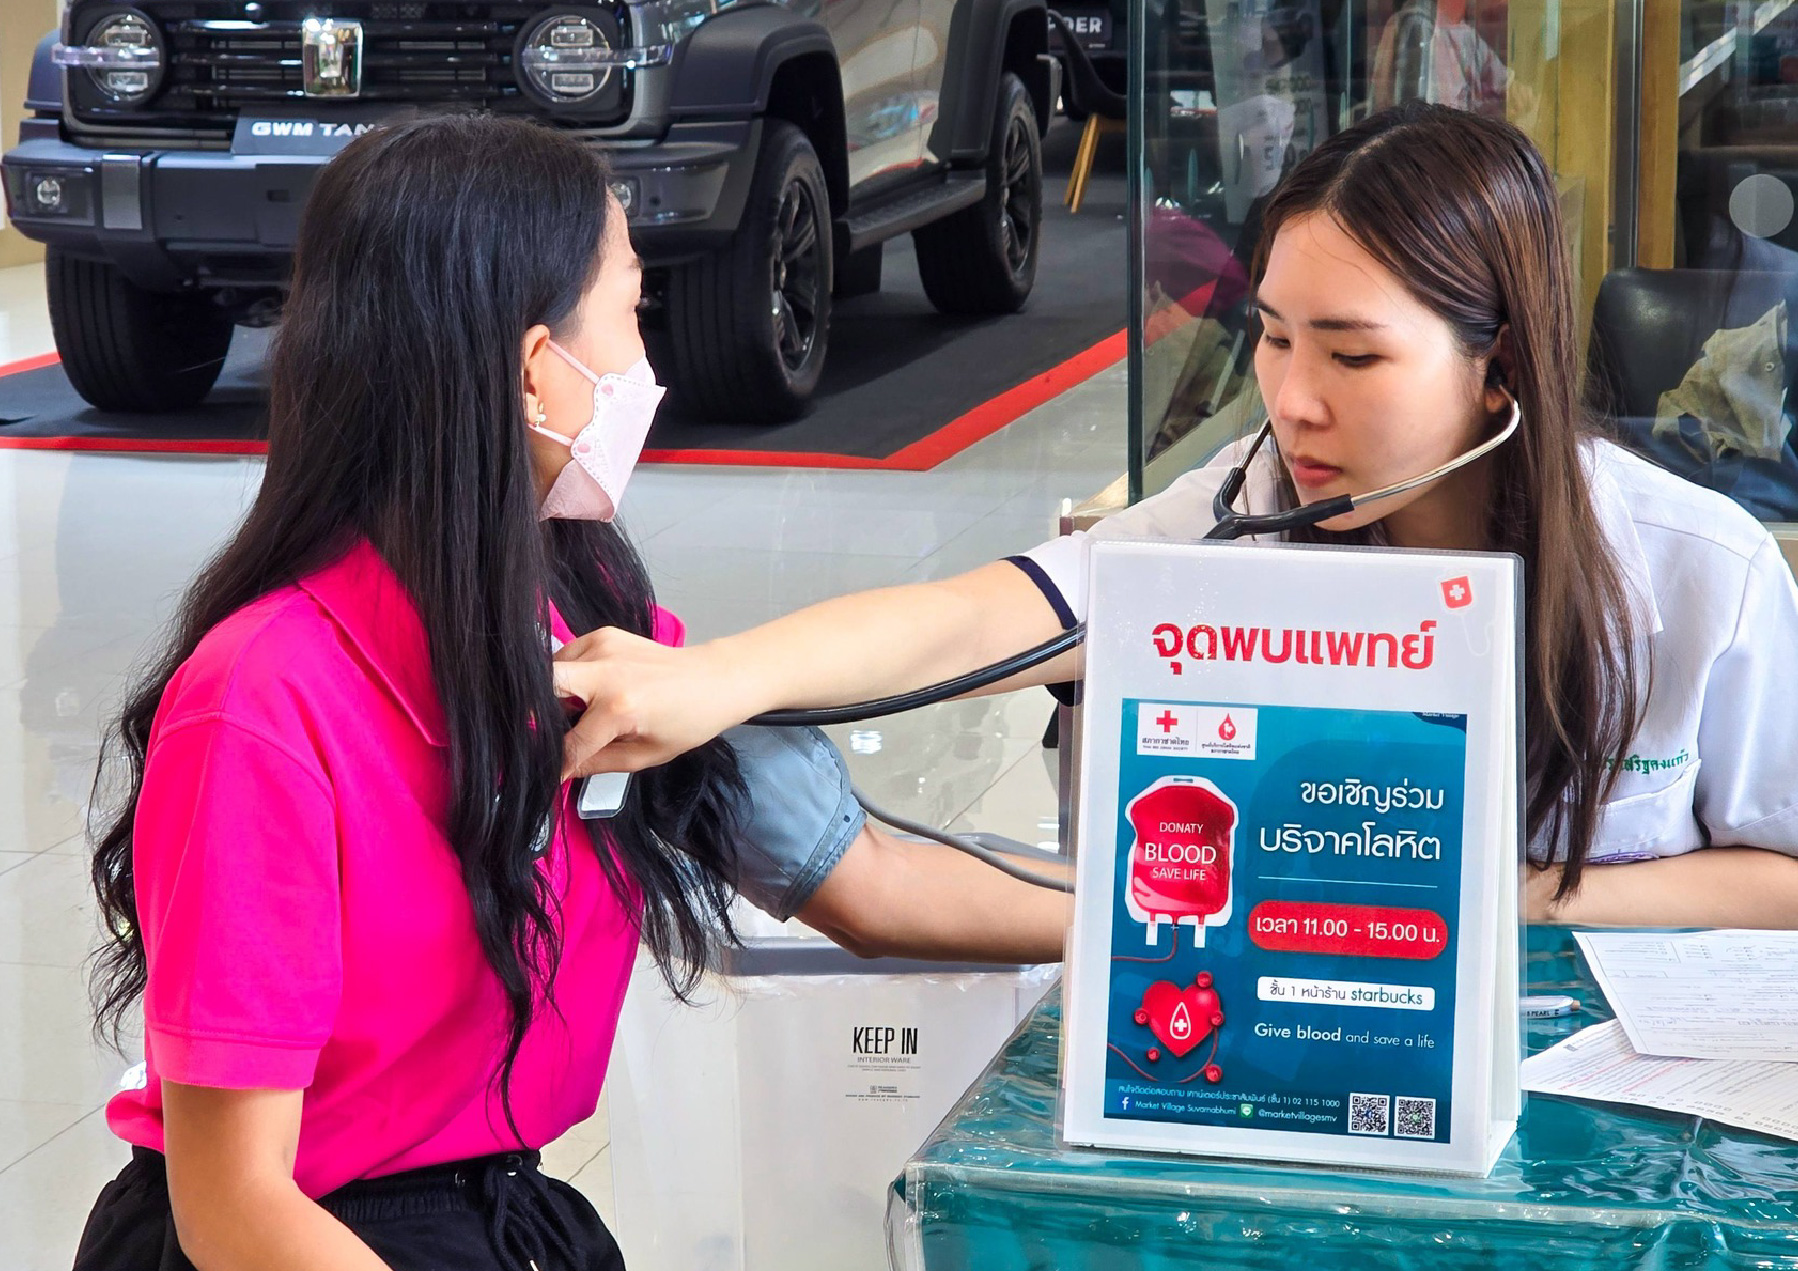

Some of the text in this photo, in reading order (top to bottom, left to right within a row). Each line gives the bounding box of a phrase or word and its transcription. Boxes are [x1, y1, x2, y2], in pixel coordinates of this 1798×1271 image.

[252, 121, 378, 137] GWM TAN
[1151, 619, 1437, 676] จุดพบแพทย์
[1300, 777, 1445, 814] ขอเชิญร่วม
[1159, 821, 1204, 834] DONATY
[1259, 821, 1441, 860] บริจาคโลหิต
[1144, 842, 1217, 865] BLOOD
[1152, 866, 1207, 881] SAVE LIFE
[1256, 917, 1298, 934] เวลา
[1303, 918, 1348, 937] 11.00
[1367, 922, 1418, 942] 15.00
[1422, 926, 1440, 943] น.
[1269, 979, 1423, 1005] ชั้น 1 หน้าร้าน starbucks
[853, 1026, 918, 1055] KEEP IN
[1254, 1022, 1435, 1049] Give blood and save a life
[857, 1056, 911, 1064] INTERIOR WARE
[1135, 1100, 1237, 1115] Market Village Suvarnabhumi
[1292, 1097, 1302, 1105] 02
[1257, 1108, 1338, 1123] @marketvillagesmv
